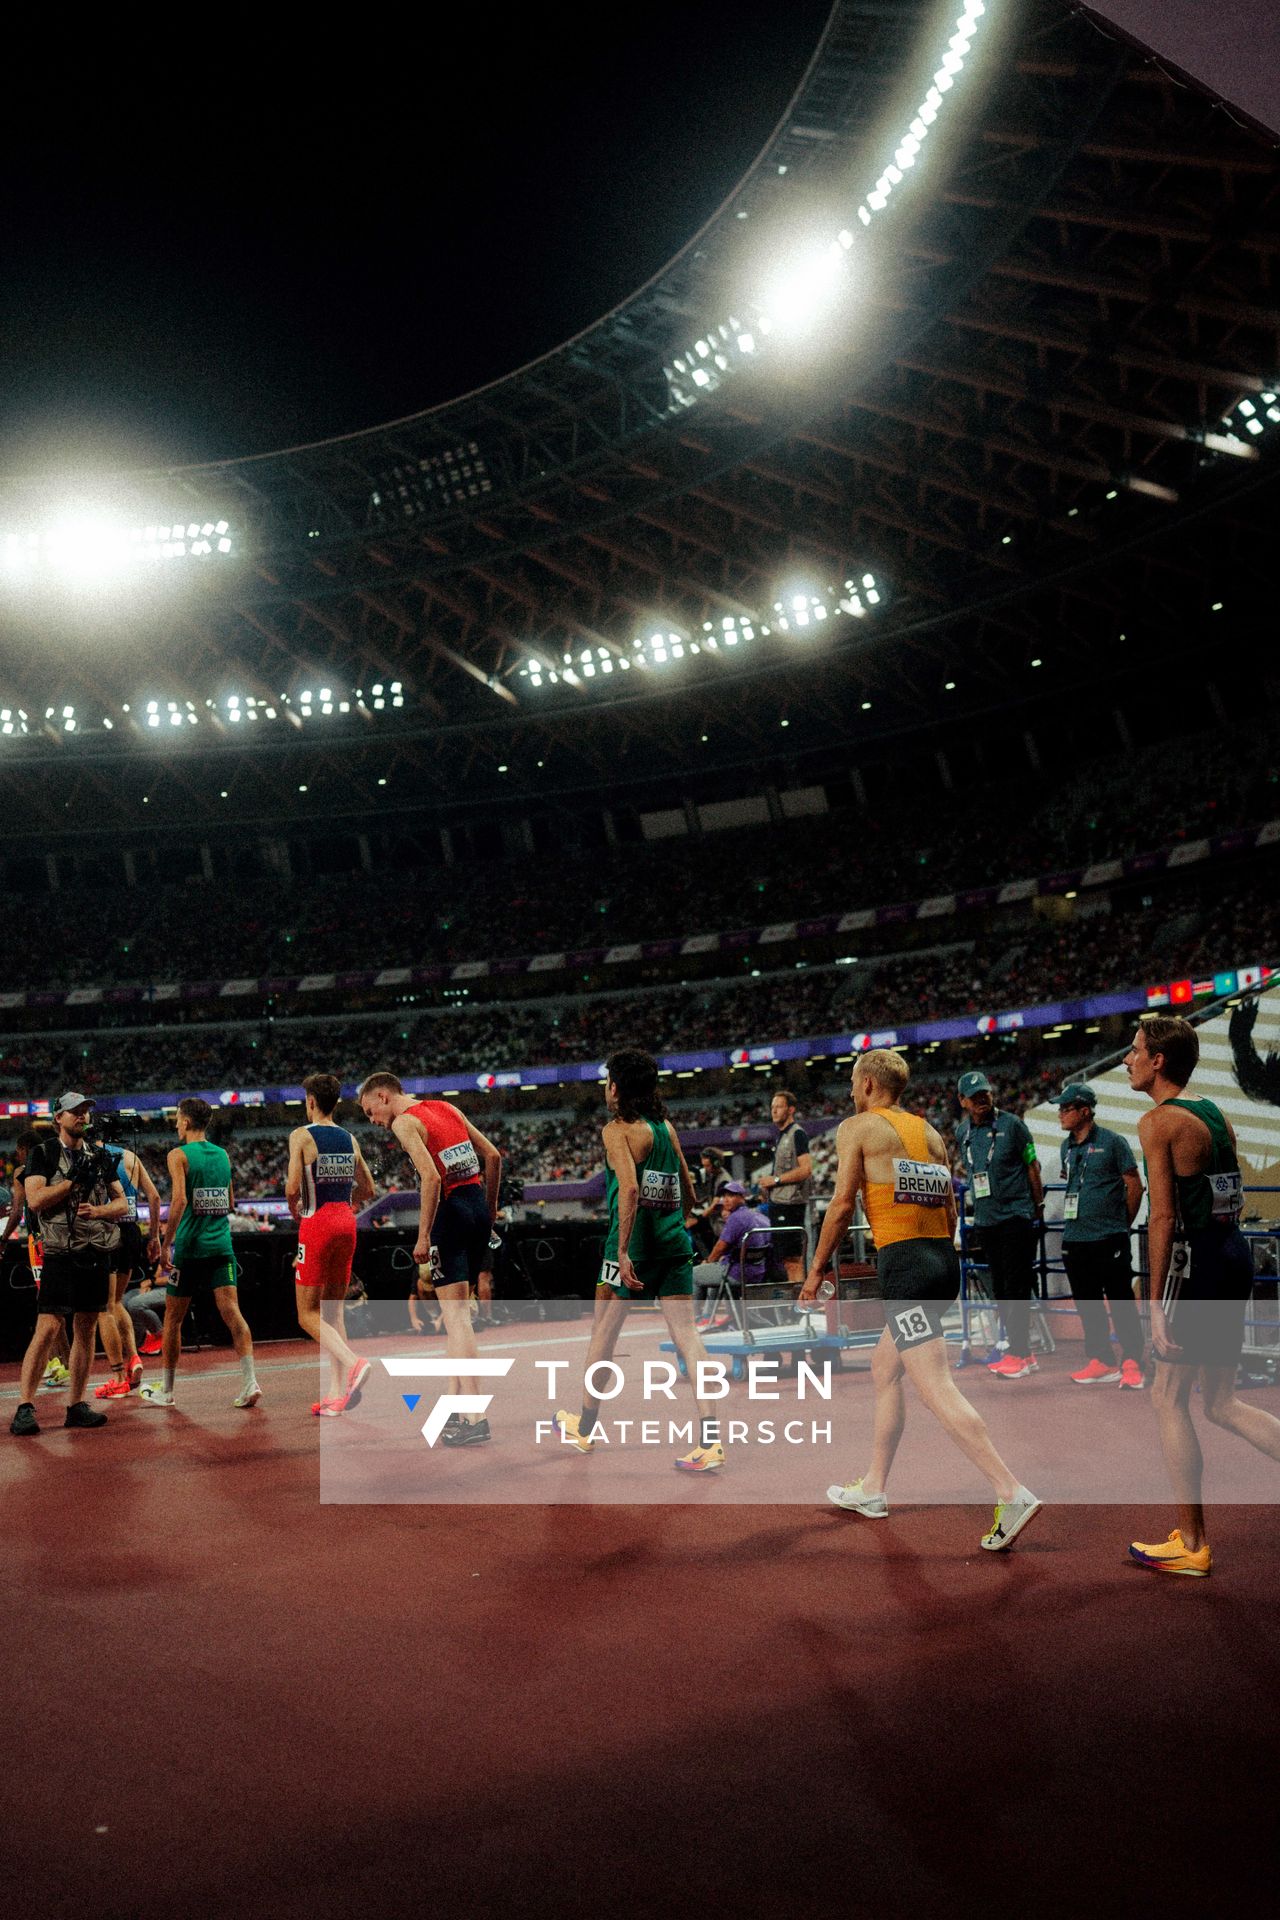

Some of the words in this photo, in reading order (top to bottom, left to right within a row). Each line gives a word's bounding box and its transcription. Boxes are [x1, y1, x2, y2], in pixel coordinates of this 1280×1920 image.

[450, 1142, 473, 1157] TDK
[328, 1154, 353, 1164] TDK
[908, 1161, 948, 1177] TDK
[658, 1173, 679, 1186] TD
[899, 1176, 949, 1194] BREMM
[204, 1188, 226, 1198] TDK
[194, 1198, 228, 1209] ROBINSON
[604, 1262, 621, 1282] 17
[899, 1312, 928, 1338] 18
